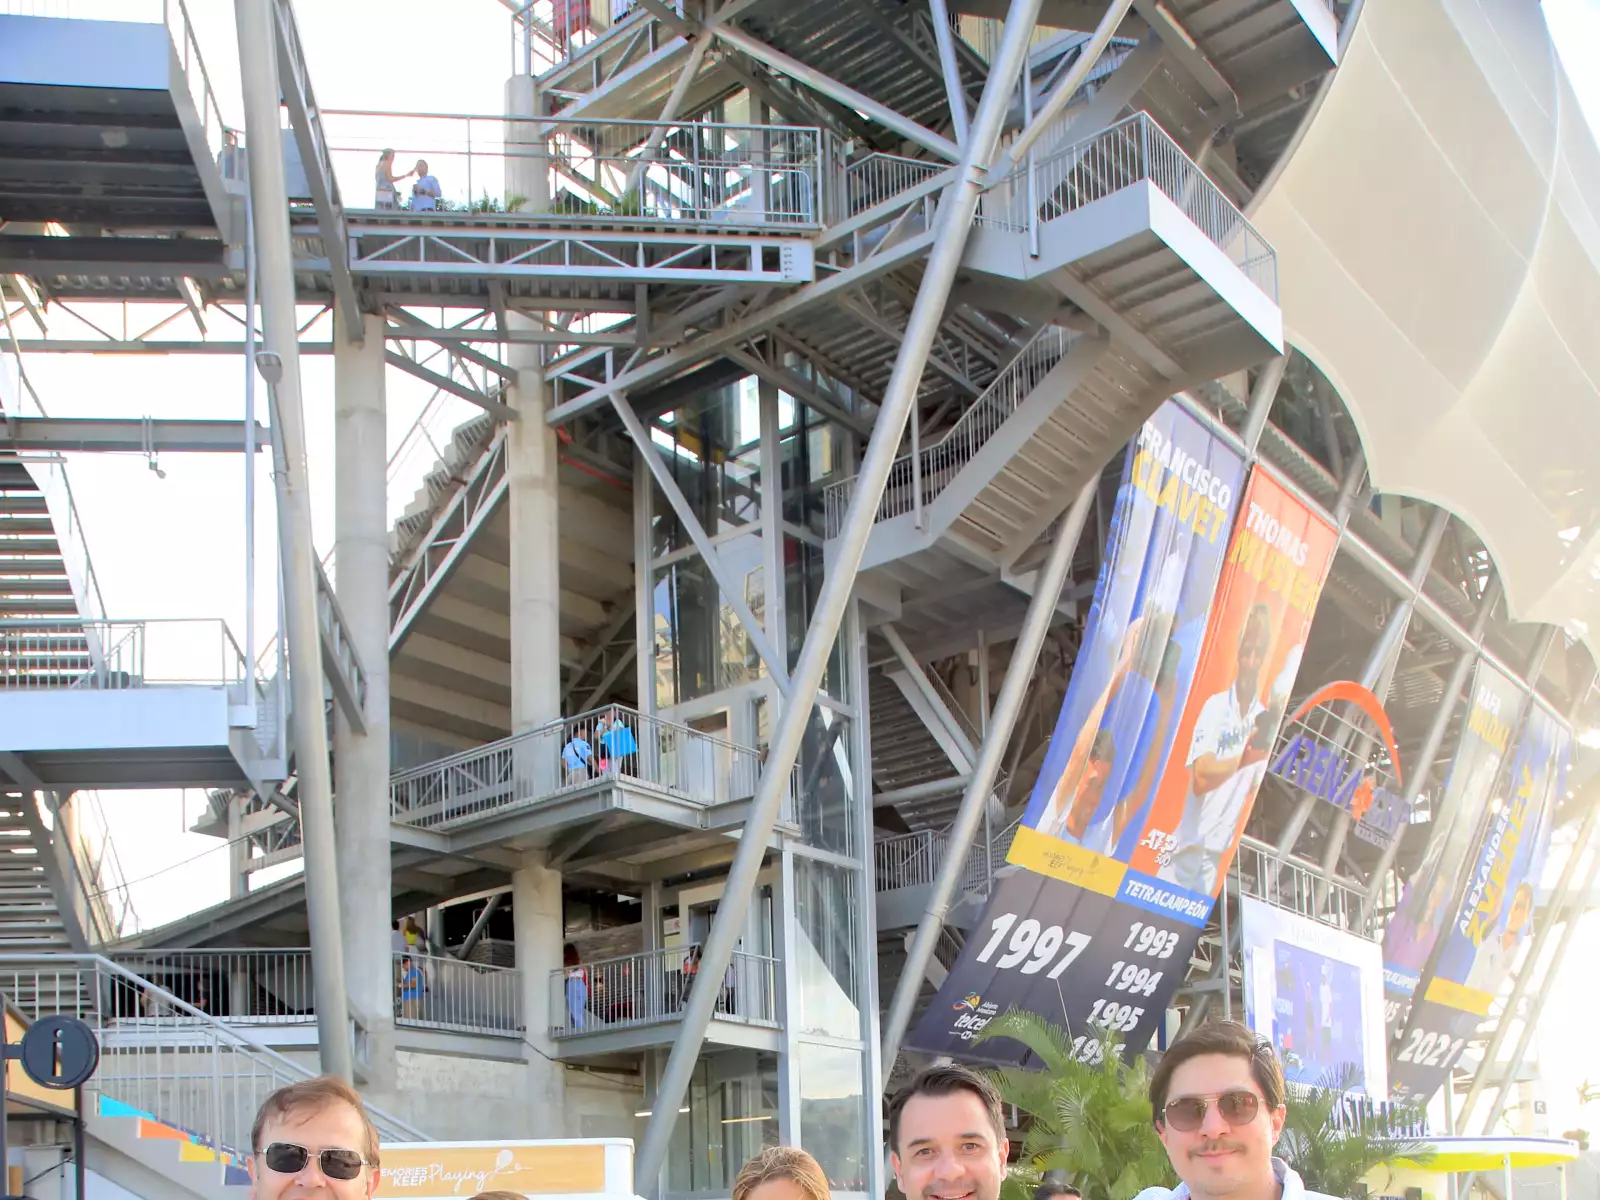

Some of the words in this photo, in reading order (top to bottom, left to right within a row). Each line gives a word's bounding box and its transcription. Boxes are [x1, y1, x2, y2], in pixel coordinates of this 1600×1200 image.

[1137, 420, 1232, 510] FRANCISCO
[1132, 449, 1228, 544] CLAVET
[1245, 501, 1309, 567] THOMAS
[1271, 734, 1364, 812] ARENA
[1140, 829, 1178, 854] ATP
[1154, 852, 1171, 867] 500
[1459, 804, 1512, 936] ALEXANDER
[1124, 879, 1210, 921] TETRACAMPEÓN
[976, 912, 1092, 980] 1997
[1123, 921, 1180, 960] 1993
[1104, 960, 1164, 997] 1994
[953, 1012, 992, 1031] telcel
[1086, 999, 1145, 1033] 1995
[1397, 1028, 1464, 1068] 2021
[380, 1166, 428, 1177] EMORIES
[393, 1175, 428, 1187] KEEP
[428, 1162, 489, 1193] Playing
